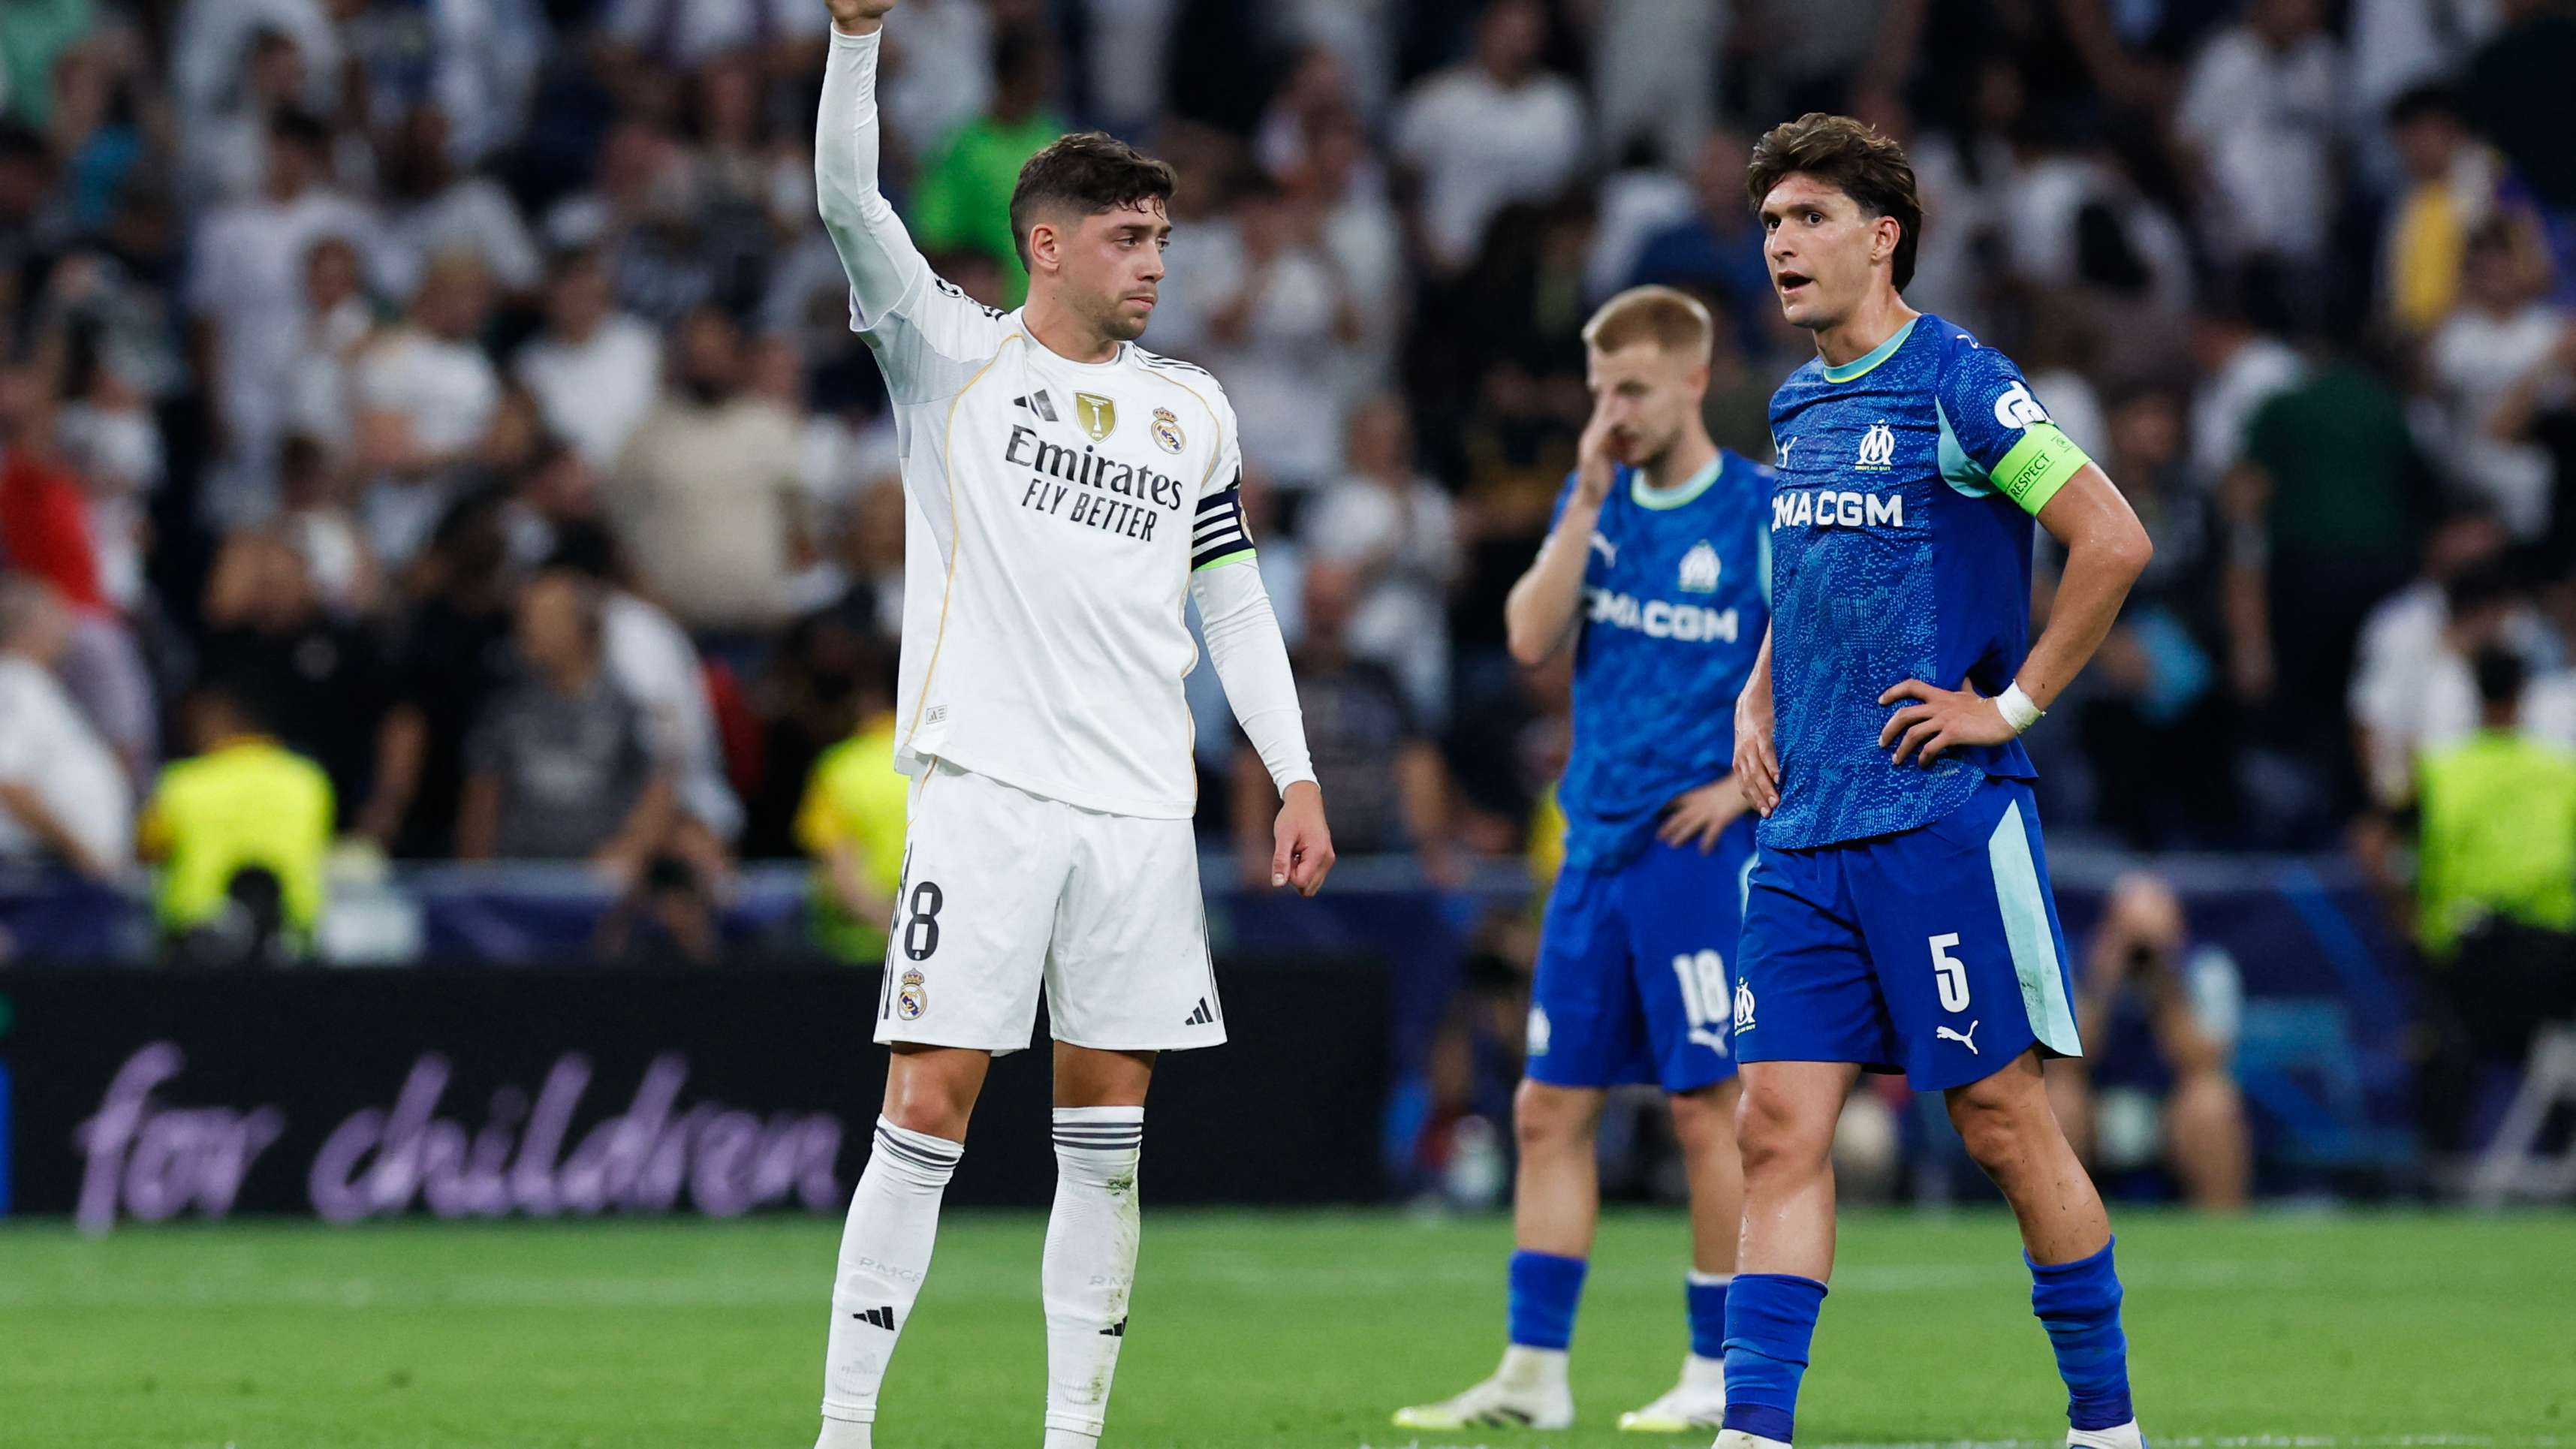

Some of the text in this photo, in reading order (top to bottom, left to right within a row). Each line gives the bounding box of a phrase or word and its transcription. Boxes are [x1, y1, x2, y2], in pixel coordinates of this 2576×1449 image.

[1005, 424, 1183, 511] Emirates
[2011, 453, 2050, 498] RESPECT
[1022, 478, 1158, 542] FLY BETTER
[904, 881, 943, 961] 8
[1673, 950, 1731, 1027] 18
[1929, 932, 1970, 1013] 5
[77, 1042, 842, 1240] for children
